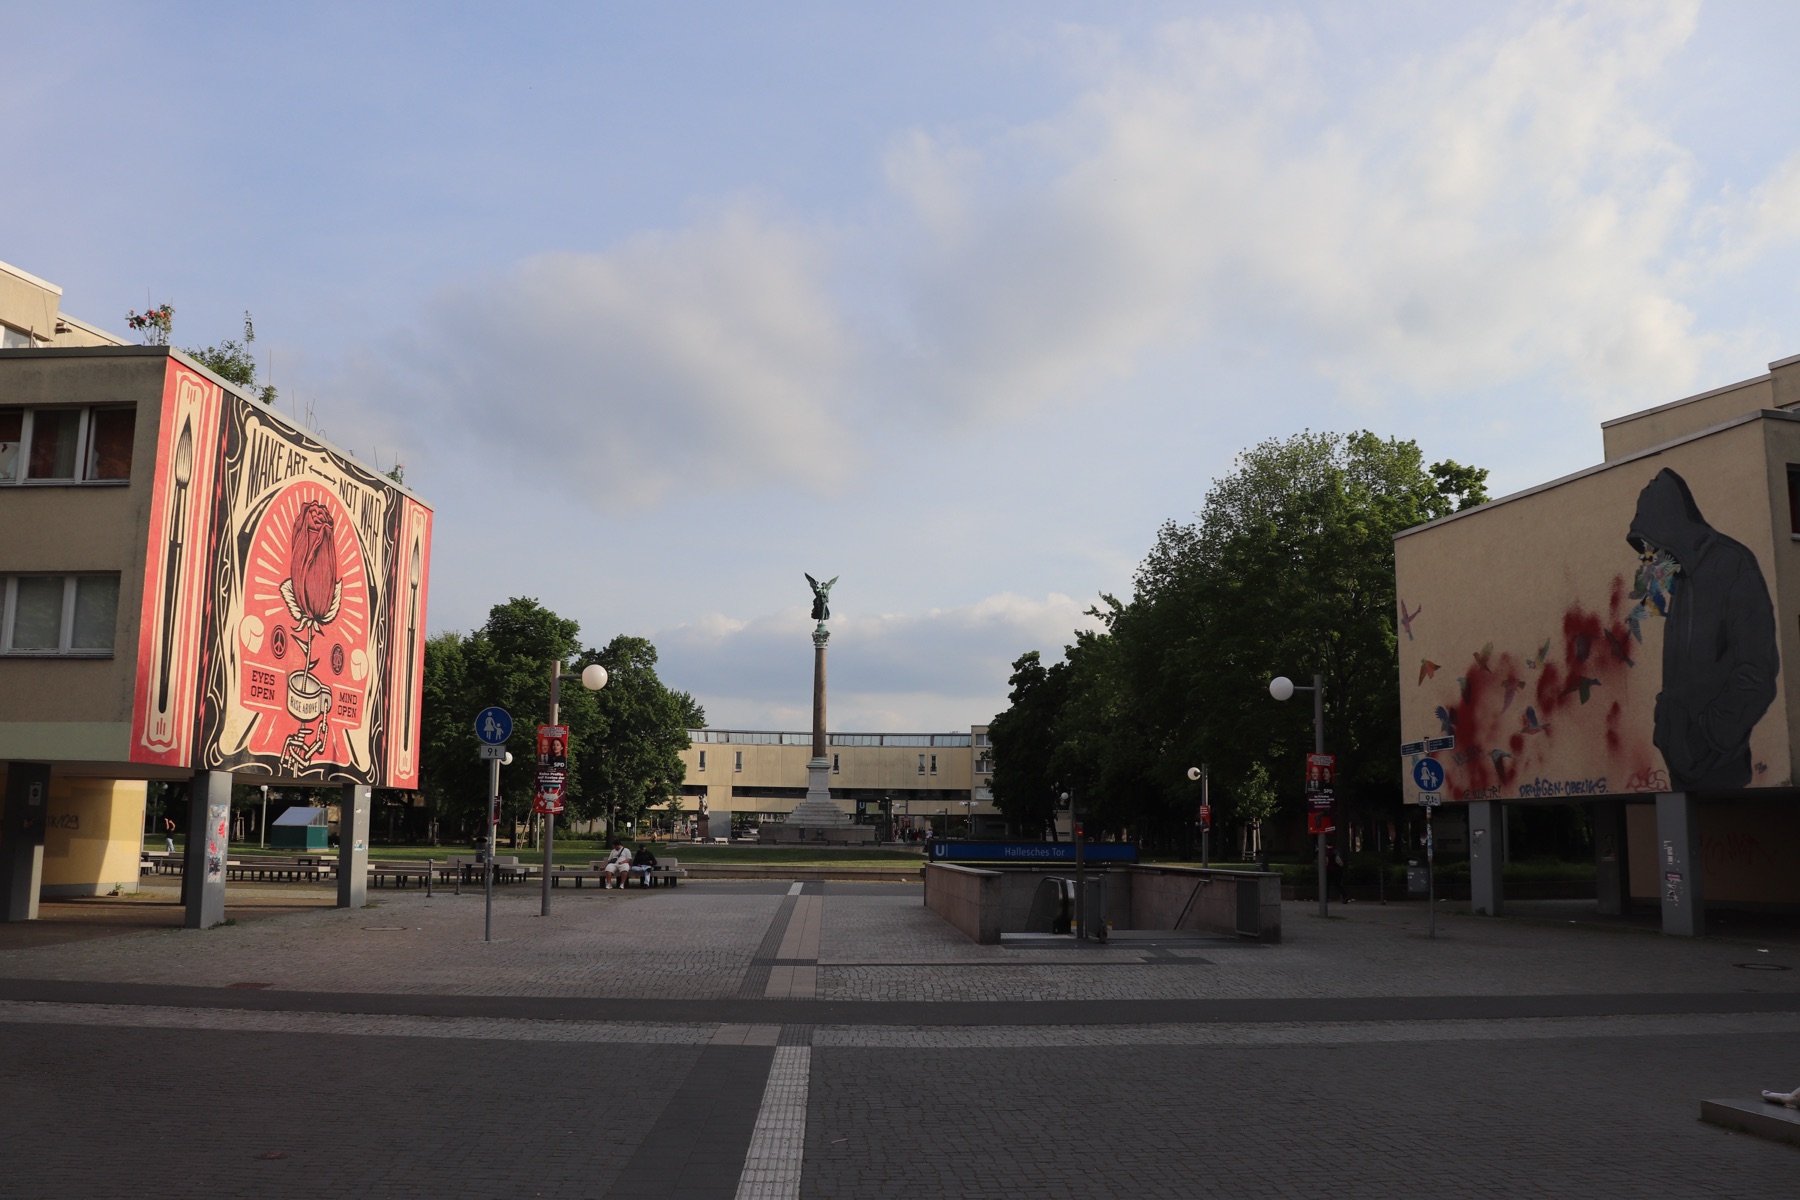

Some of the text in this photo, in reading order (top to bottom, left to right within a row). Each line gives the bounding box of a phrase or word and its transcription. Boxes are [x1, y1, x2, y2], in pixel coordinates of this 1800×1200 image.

[246, 428, 381, 566] MAKE ART NOT WAR
[252, 670, 276, 686] EYES
[250, 685, 276, 701] OPEN
[338, 691, 358, 705] MIND
[289, 696, 318, 715] RISE ABOVE
[337, 704, 357, 718] OPEN
[935, 844, 1066, 857] U Hallesches Tor
